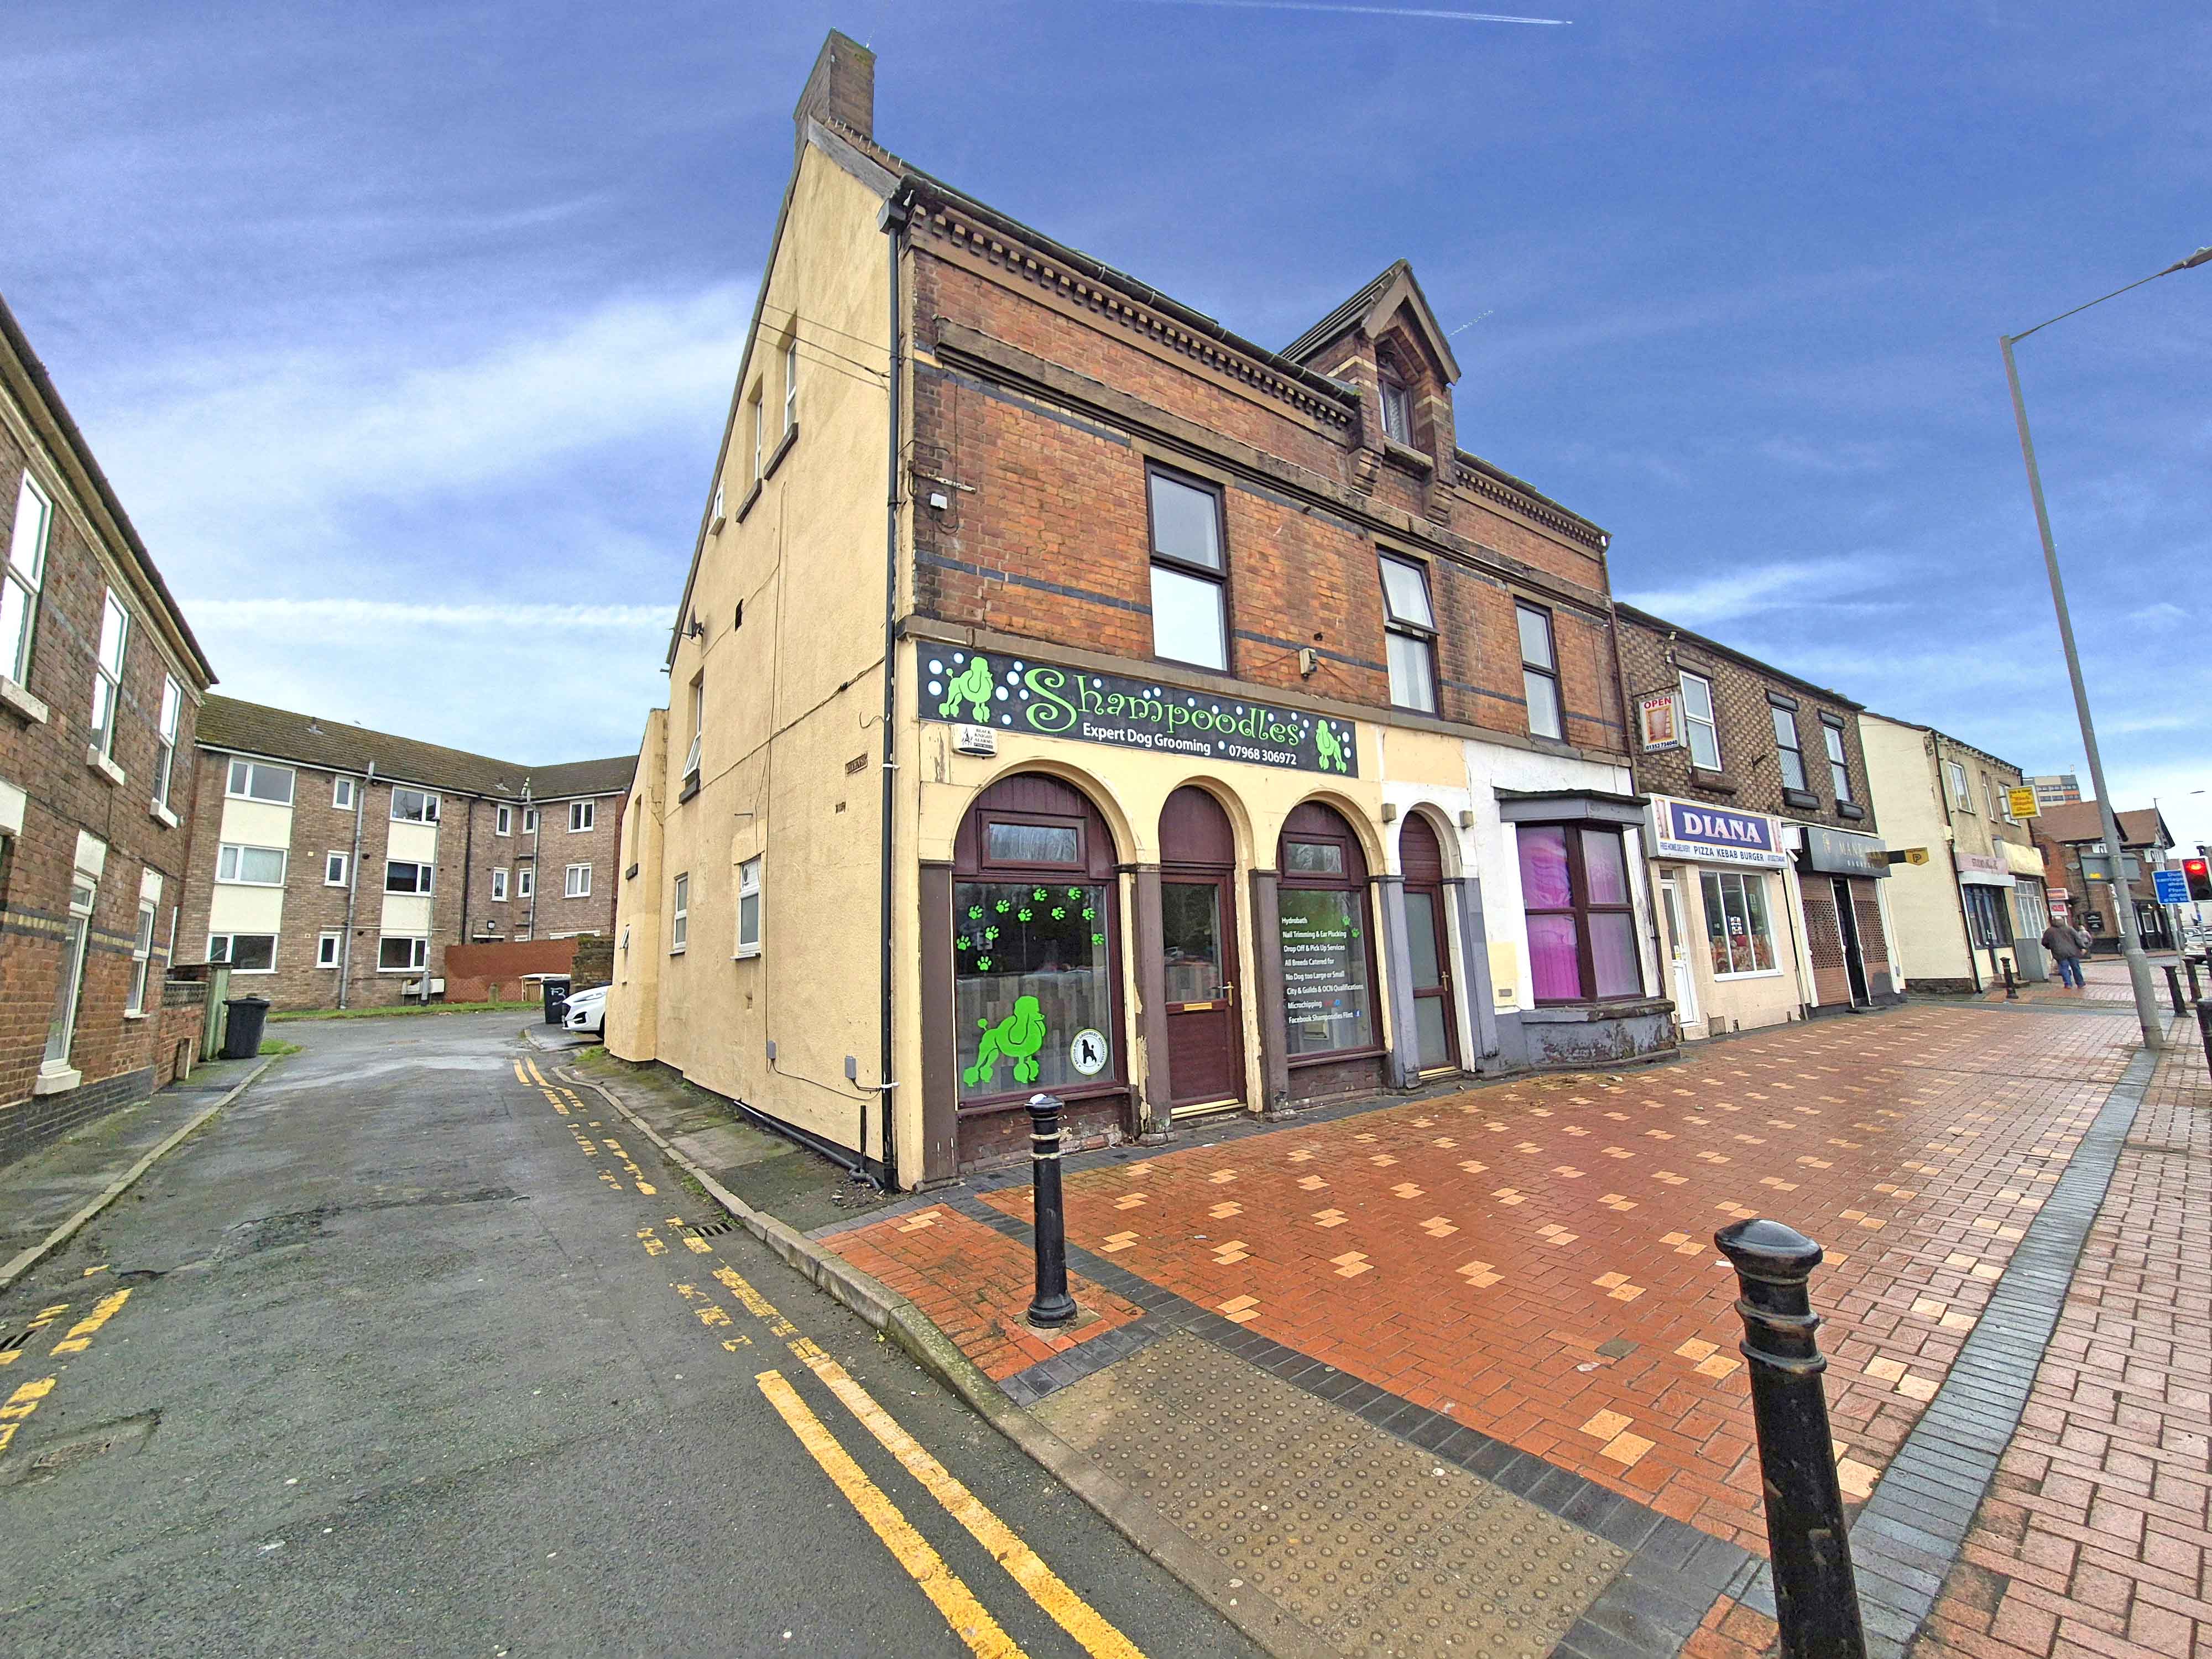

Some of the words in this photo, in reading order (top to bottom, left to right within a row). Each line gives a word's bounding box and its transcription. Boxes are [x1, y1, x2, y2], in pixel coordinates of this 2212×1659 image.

[1024, 668, 1300, 747] Shampoodles
[1644, 697, 1672, 709] OPEN
[1083, 722, 1125, 742] Expert
[1126, 731, 1152, 747] Dog
[1154, 734, 1211, 755] Grooming
[1229, 744, 1260, 760] 07968
[1261, 749, 1297, 765] 306972
[1682, 811, 1762, 843] DIANA
[1693, 846, 1714, 857] PIZZA
[1716, 849, 1738, 859] KEBAB
[1740, 851, 1764, 862] BURGER
[1281, 917, 1308, 925] Hydrobath
[1293, 931, 1316, 939] Trimming
[1327, 930, 1347, 938] Plucking
[1293, 973, 1304, 982] Dog
[1313, 972, 1327, 980] Large
[1286, 987, 1297, 996] City
[1333, 984, 1364, 992] Qualifications
[1287, 1000, 1322, 1009] Microchipping
[1288, 1015, 1312, 1024] Facebook
[1312, 1013, 1343, 1022] Shampoodles
